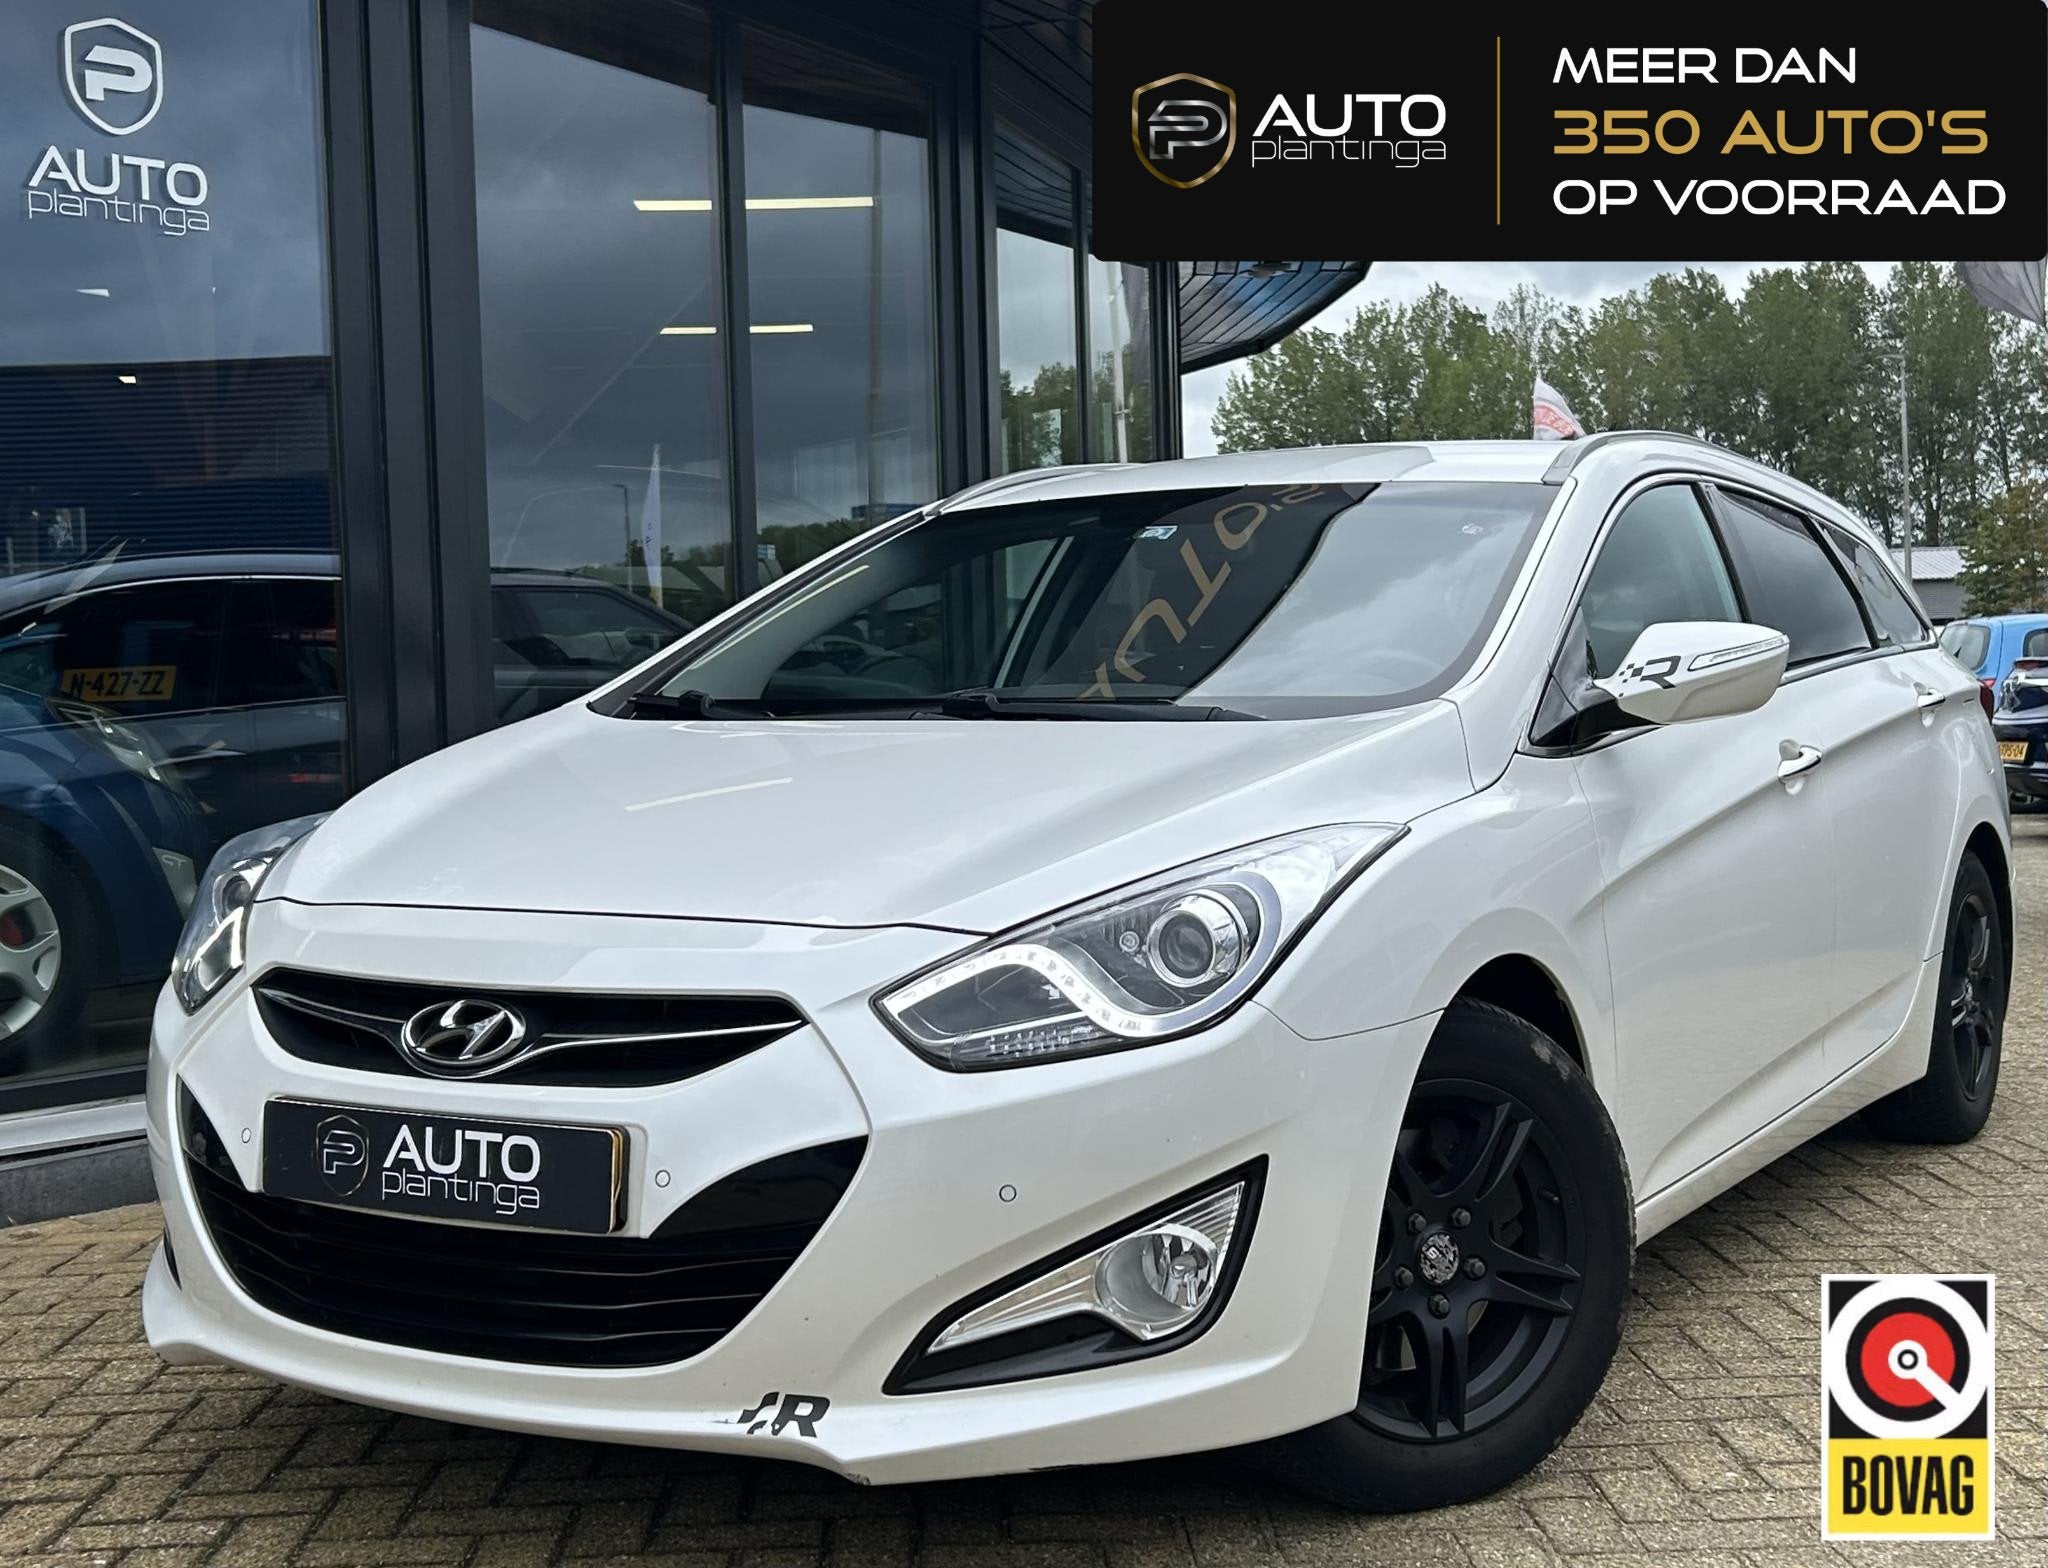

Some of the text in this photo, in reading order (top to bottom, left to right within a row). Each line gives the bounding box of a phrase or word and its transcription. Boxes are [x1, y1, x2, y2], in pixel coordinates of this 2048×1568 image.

[28, 145, 209, 207] AUTO
[28, 188, 210, 236] plantinga
[69, 670, 167, 699] N-427-ZZ
[382, 1124, 541, 1183] AUTO
[381, 1168, 541, 1216] plantinga
